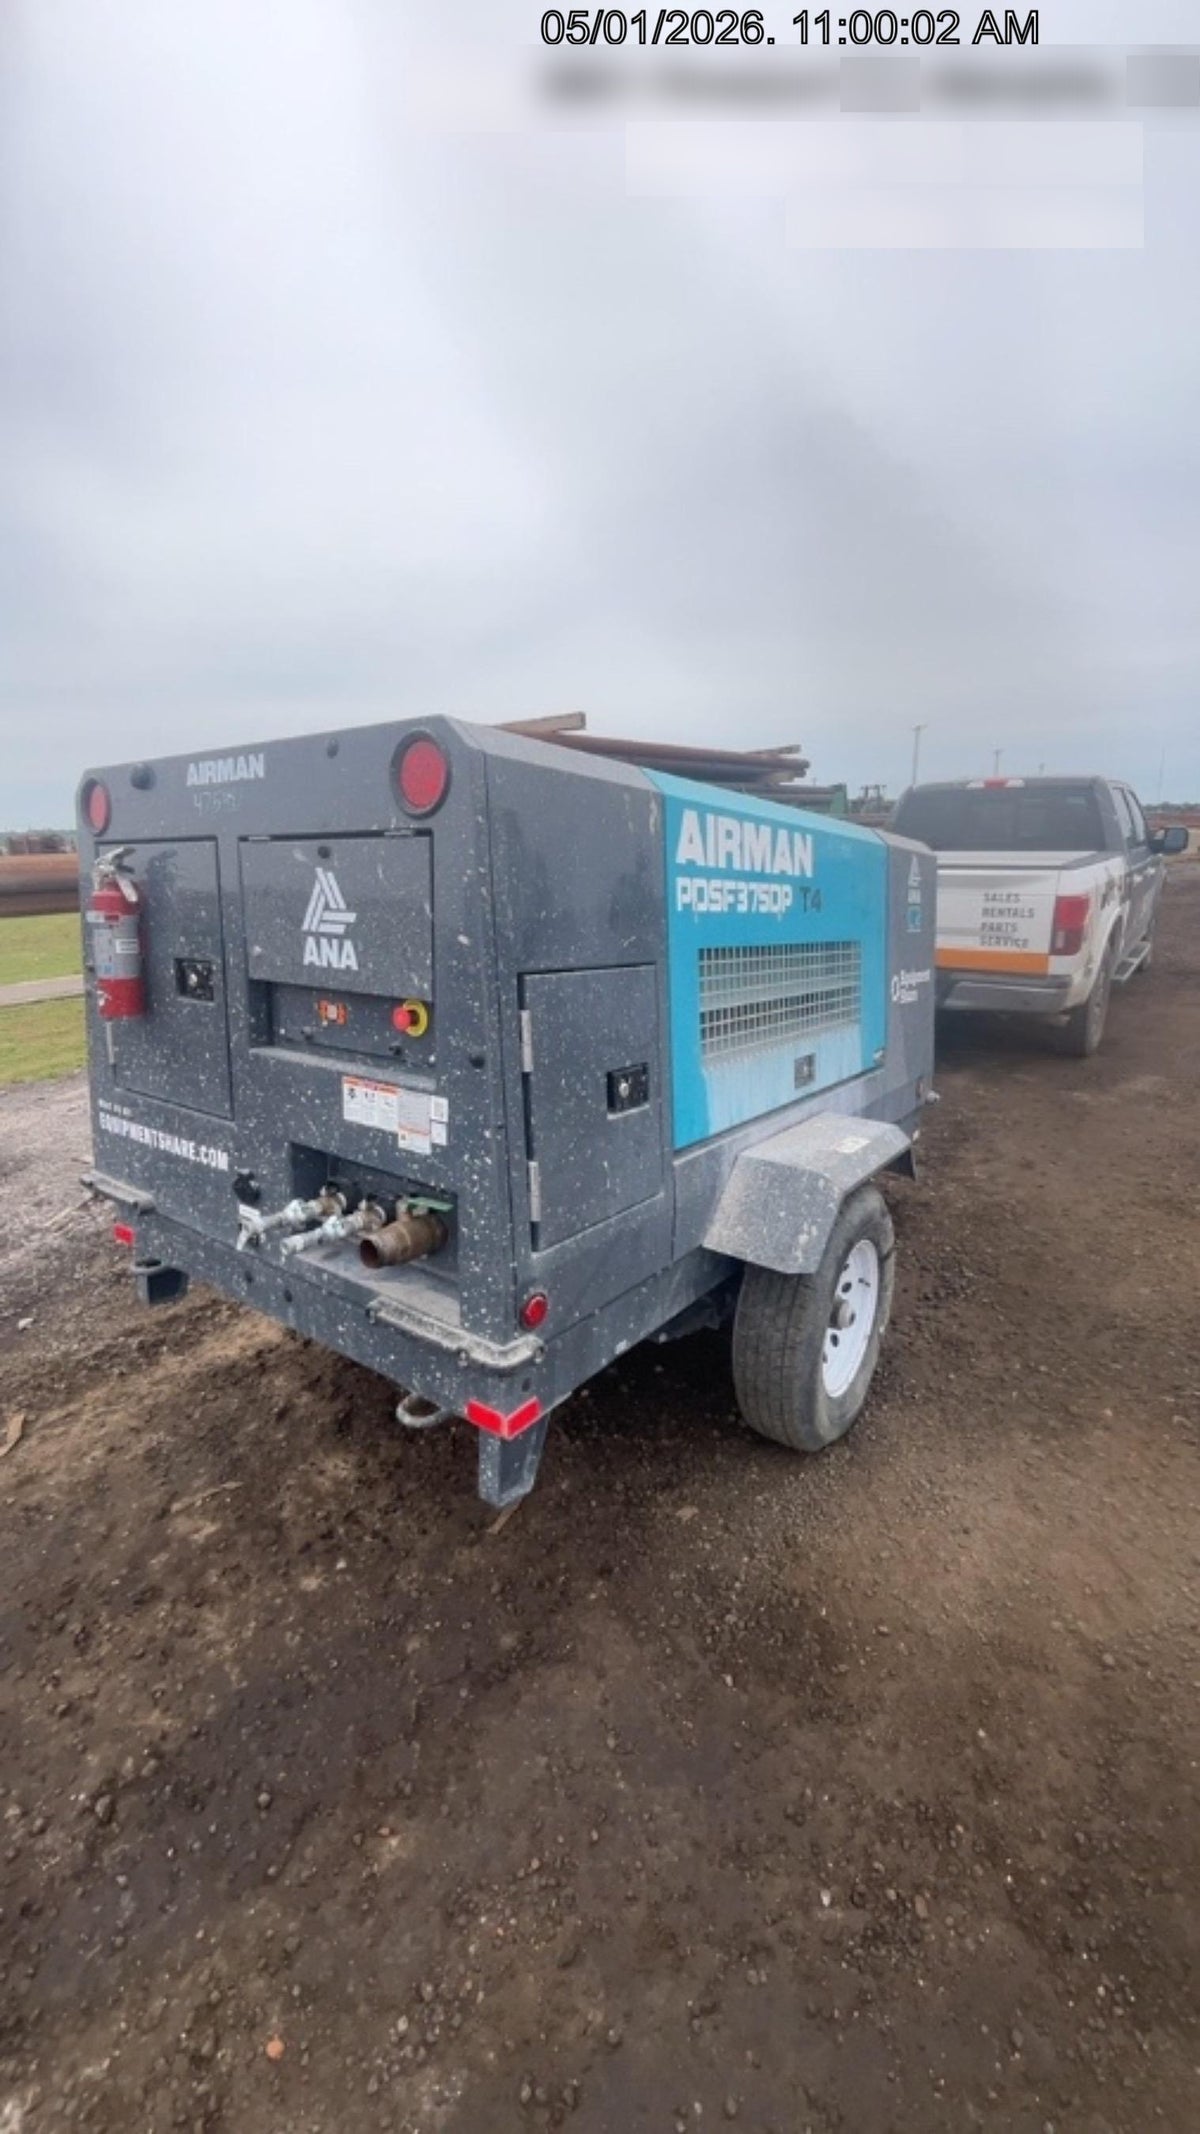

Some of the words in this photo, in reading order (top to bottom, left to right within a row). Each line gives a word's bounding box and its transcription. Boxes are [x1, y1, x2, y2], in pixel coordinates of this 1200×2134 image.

[186, 753, 265, 787] AIRMAN
[675, 808, 813, 878] AIRMAN
[801, 886, 822, 913] T4
[983, 892, 1021, 904] SALES
[981, 906, 1035, 919] RENTALS
[980, 921, 1018, 933] PARTS
[979, 935, 1030, 949] SERVICE
[303, 936, 358, 970] ANA
